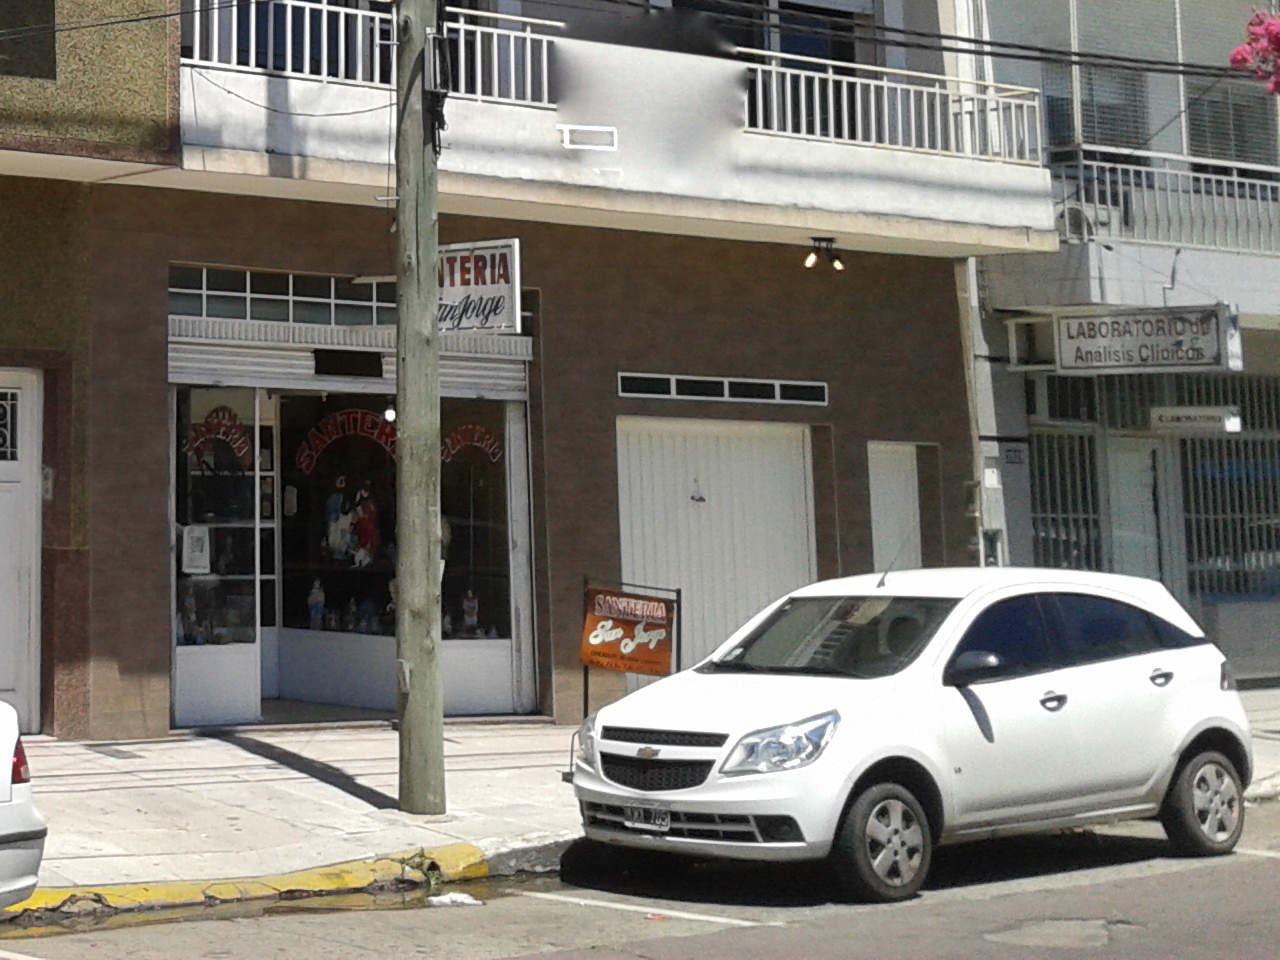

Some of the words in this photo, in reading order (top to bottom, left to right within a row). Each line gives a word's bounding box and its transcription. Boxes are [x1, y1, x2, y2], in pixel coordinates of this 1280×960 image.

[438, 252, 511, 288] NTERIA
[1066, 318, 1186, 340] LABORATORIO
[594, 594, 667, 622] SANTERIA
[588, 619, 624, 645] San
